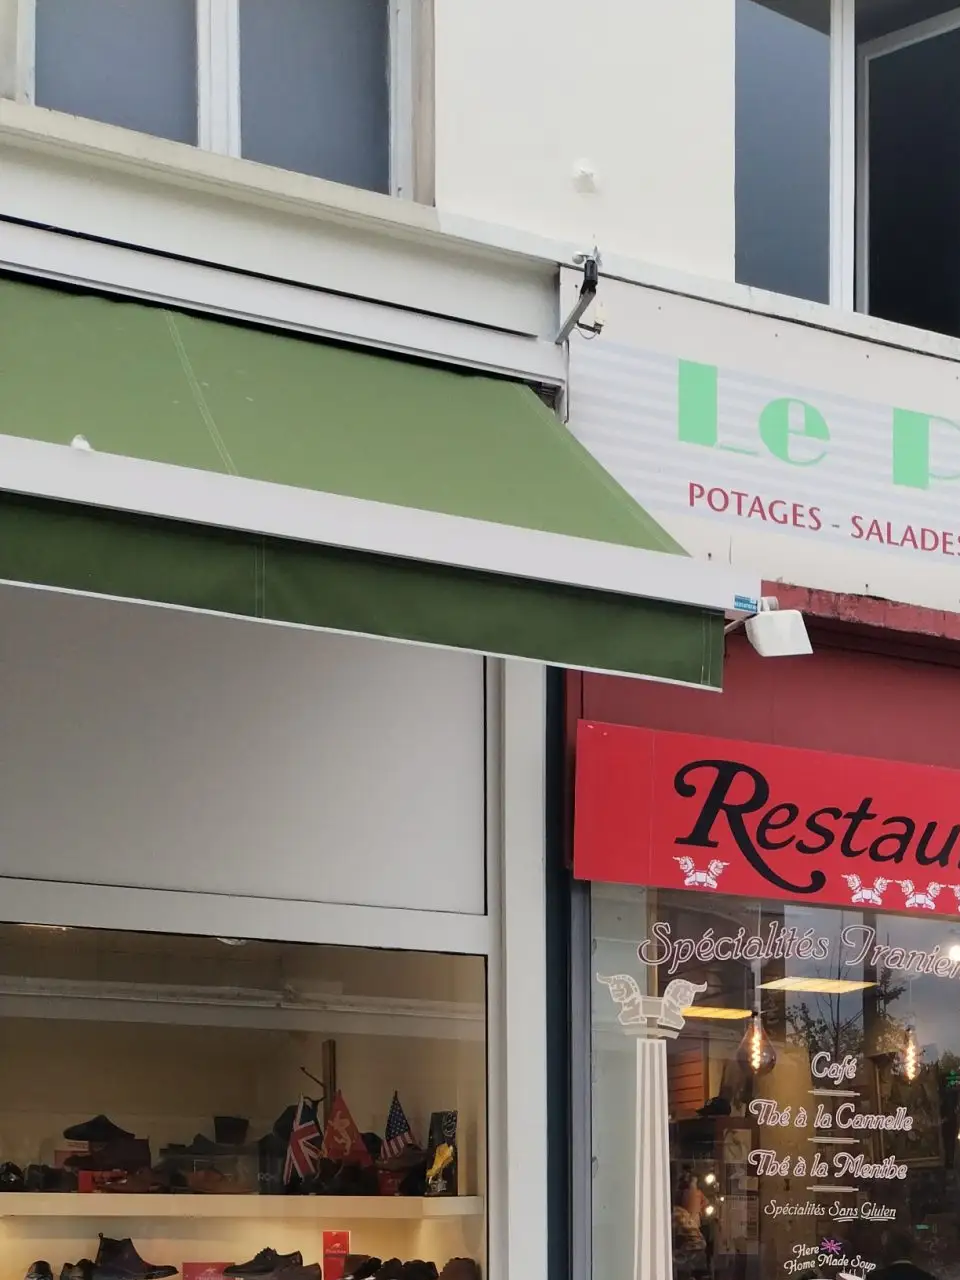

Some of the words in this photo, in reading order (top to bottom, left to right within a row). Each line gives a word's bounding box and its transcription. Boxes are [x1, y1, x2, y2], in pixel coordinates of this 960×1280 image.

[678, 357, 831, 467] Le
[688, 482, 822, 532] POTAGES
[637, 921, 829, 974] Spécialités
[811, 1051, 858, 1086] Café
[748, 1098, 791, 1128] Thé
[794, 1105, 808, 1129] à
[813, 1103, 832, 1129] la
[835, 1102, 913, 1132] Cannelle
[748, 1149, 790, 1178] Thé
[793, 1155, 808, 1178] à
[811, 1152, 829, 1178] la
[834, 1151, 908, 1181] Menthe
[764, 1199, 826, 1219] Spécialités
[829, 1200, 858, 1217] Sans
[861, 1201, 897, 1219] Gluten
[783, 1257, 816, 1275] Home
[817, 1253, 849, 1268] Made
[850, 1253, 877, 1273] Soup
[792, 1243, 819, 1260] Here
